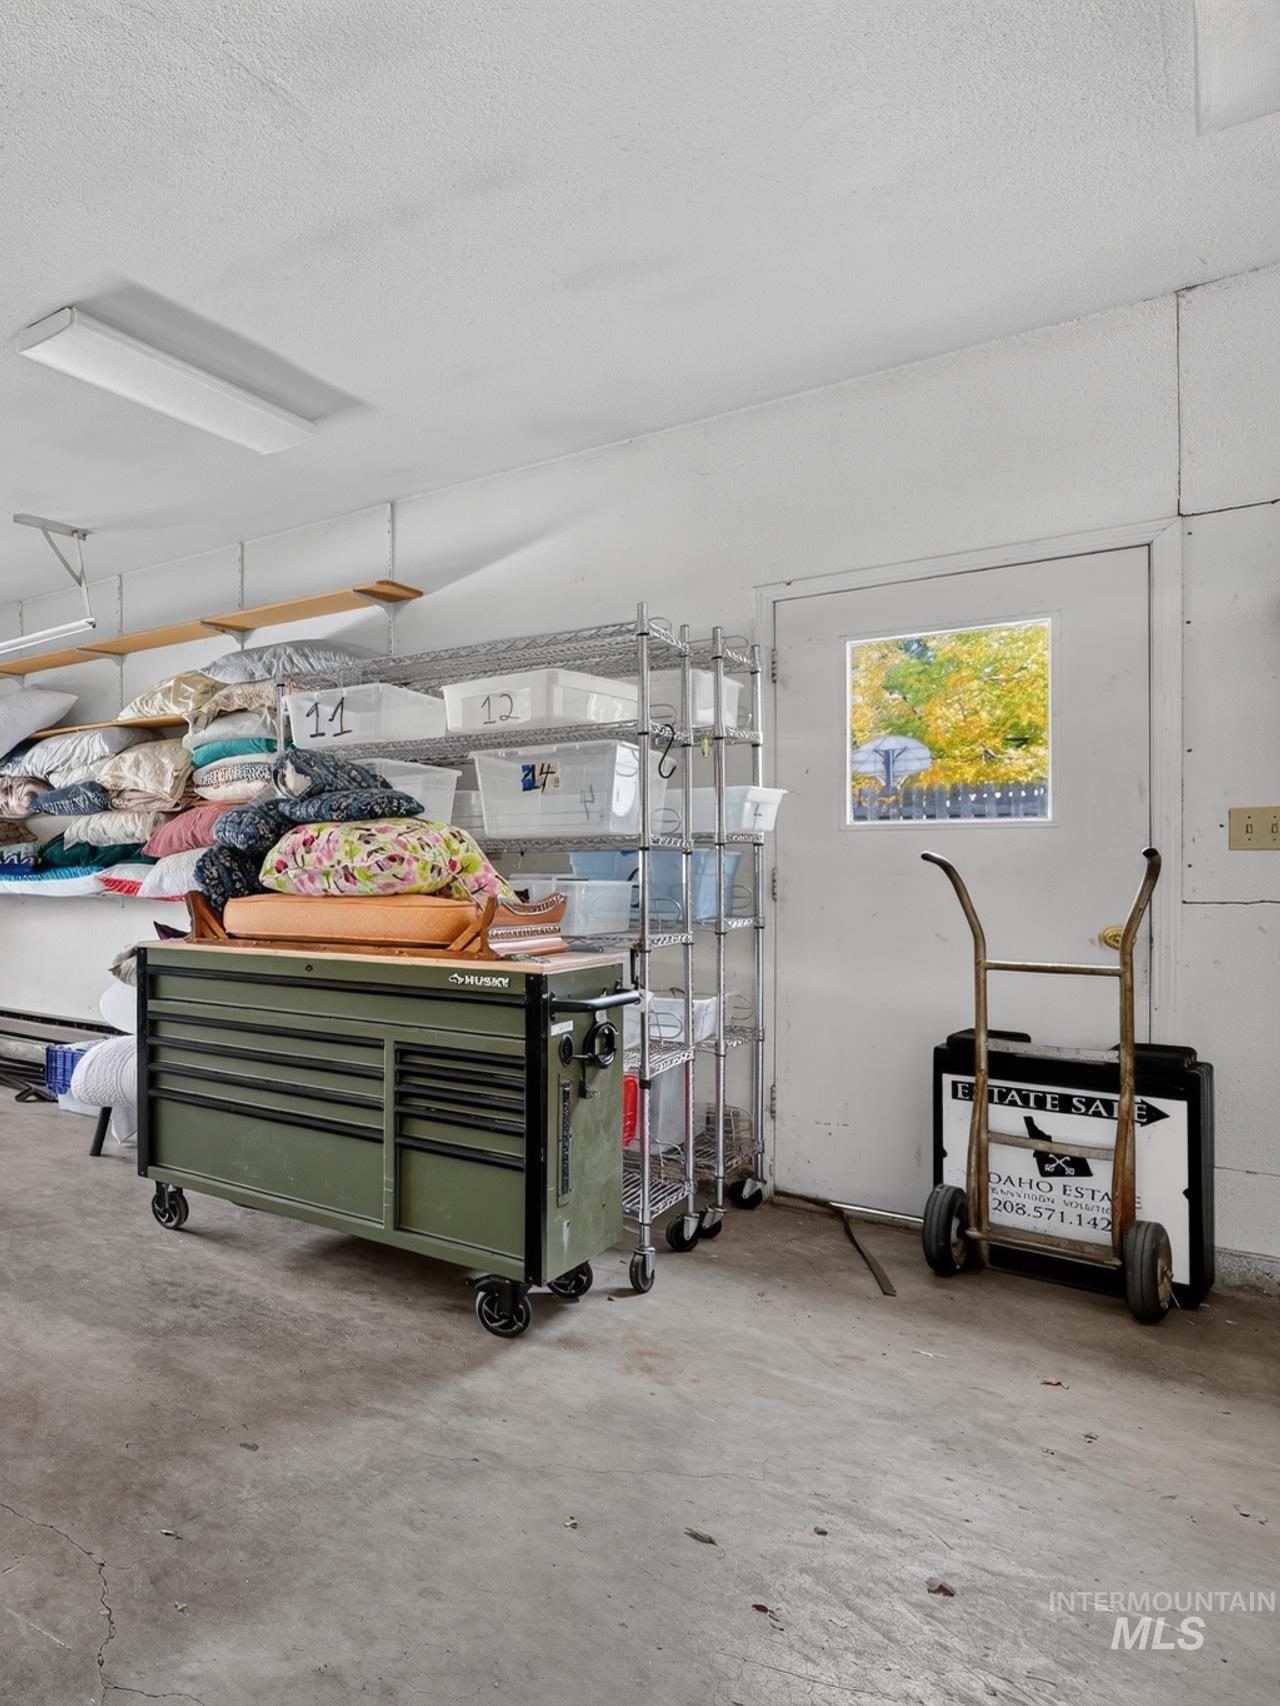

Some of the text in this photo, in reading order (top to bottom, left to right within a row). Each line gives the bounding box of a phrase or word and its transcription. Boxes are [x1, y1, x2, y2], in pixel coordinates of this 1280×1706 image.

[305, 696, 353, 738] 11
[480, 693, 520, 725] 12
[464, 975, 509, 988] HUSKY
[956, 1083, 1060, 1111] ETATE
[989, 1171, 1054, 1193] DAHO
[992, 1198, 1112, 1233] 208.571.142
